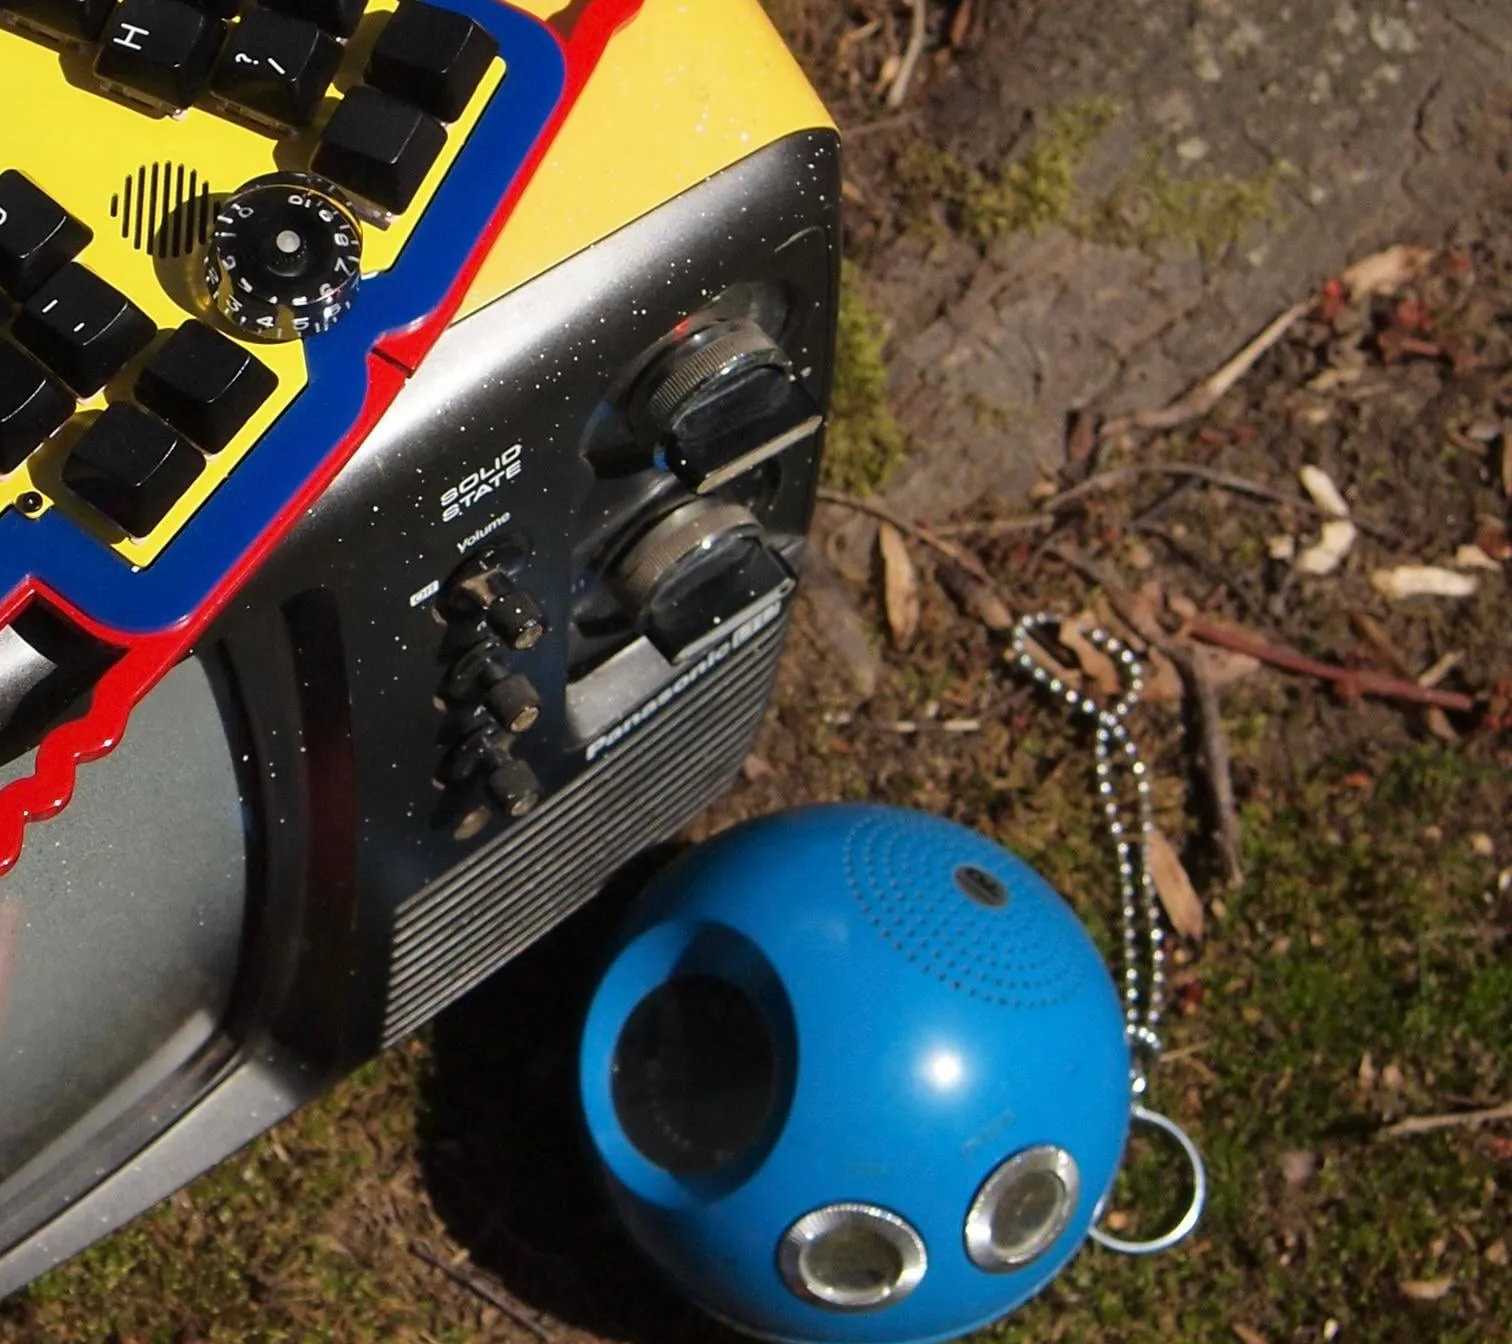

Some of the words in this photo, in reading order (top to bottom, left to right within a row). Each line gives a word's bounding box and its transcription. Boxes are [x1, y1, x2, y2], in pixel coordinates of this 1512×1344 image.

[113, 23, 150, 50] H
[441, 444, 522, 506] SOLID
[442, 460, 521, 522] STATE
[457, 512, 511, 554] Volume
